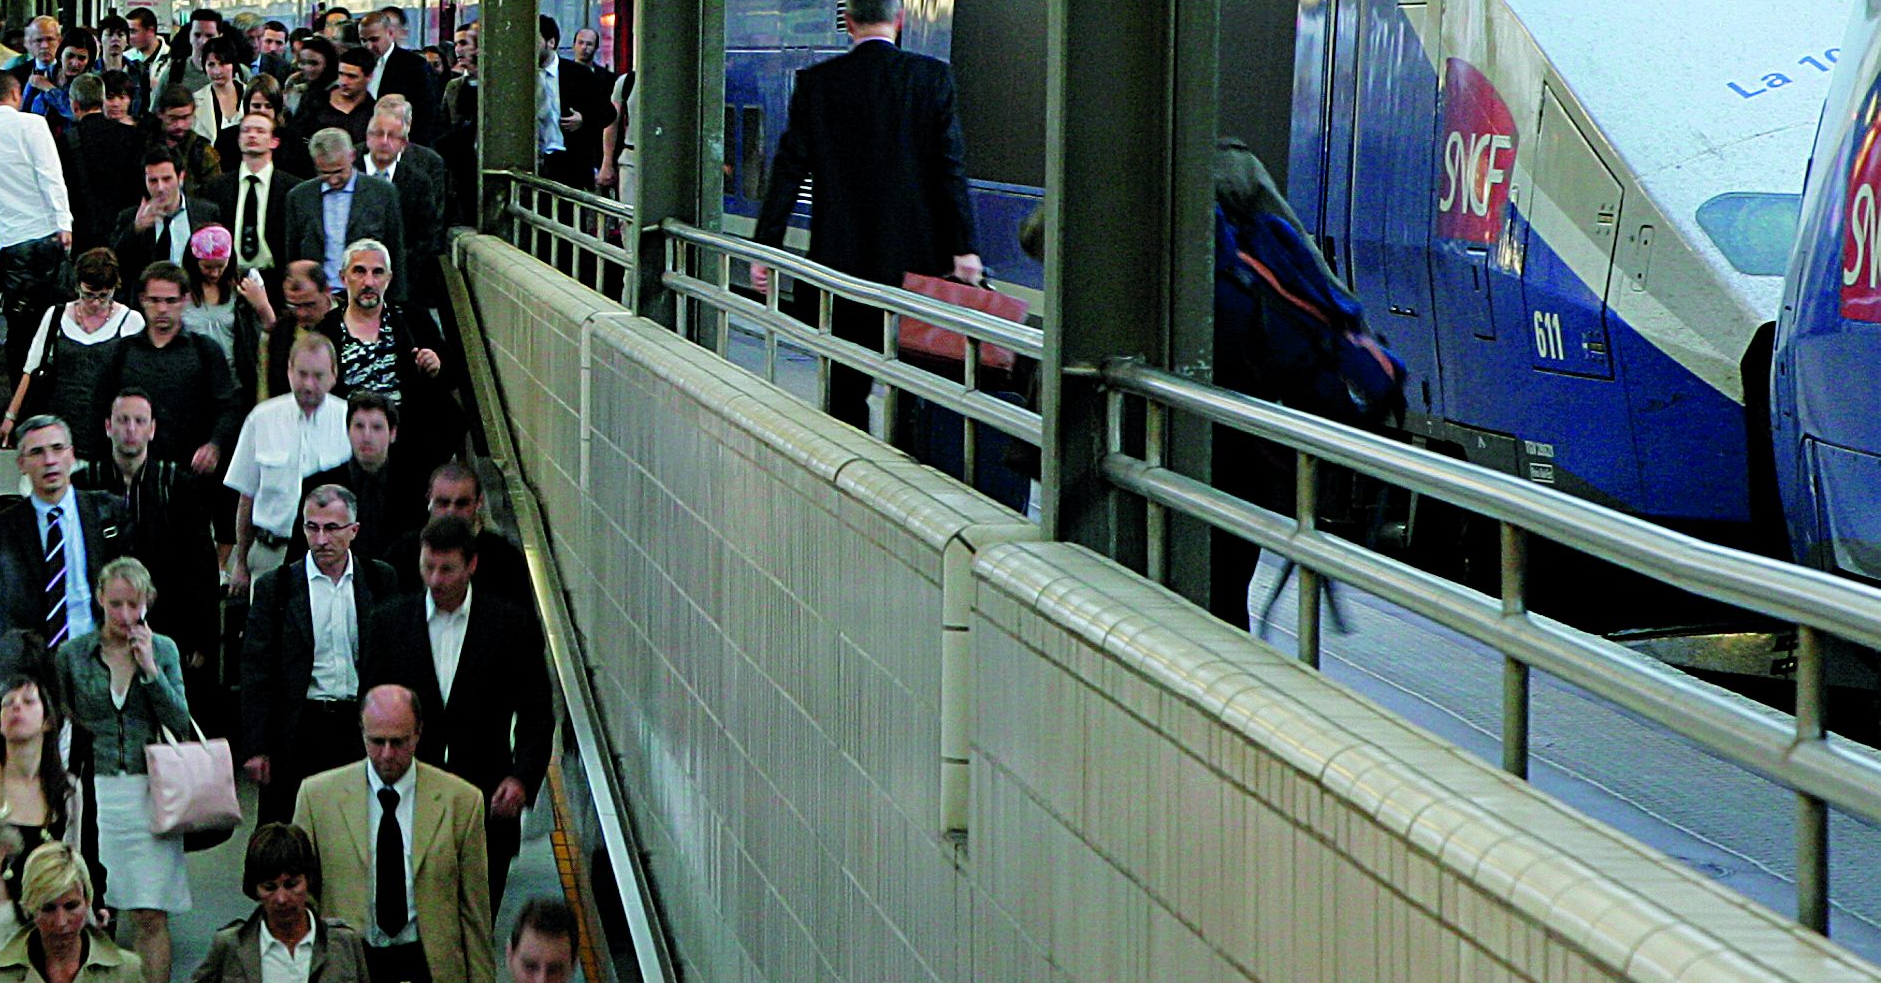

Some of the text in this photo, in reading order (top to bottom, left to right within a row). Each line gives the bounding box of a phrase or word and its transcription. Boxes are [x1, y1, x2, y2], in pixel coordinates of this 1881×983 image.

[1726, 72, 1793, 99] La
[1439, 131, 1512, 217] SNCF
[1534, 310, 1564, 360] 611
